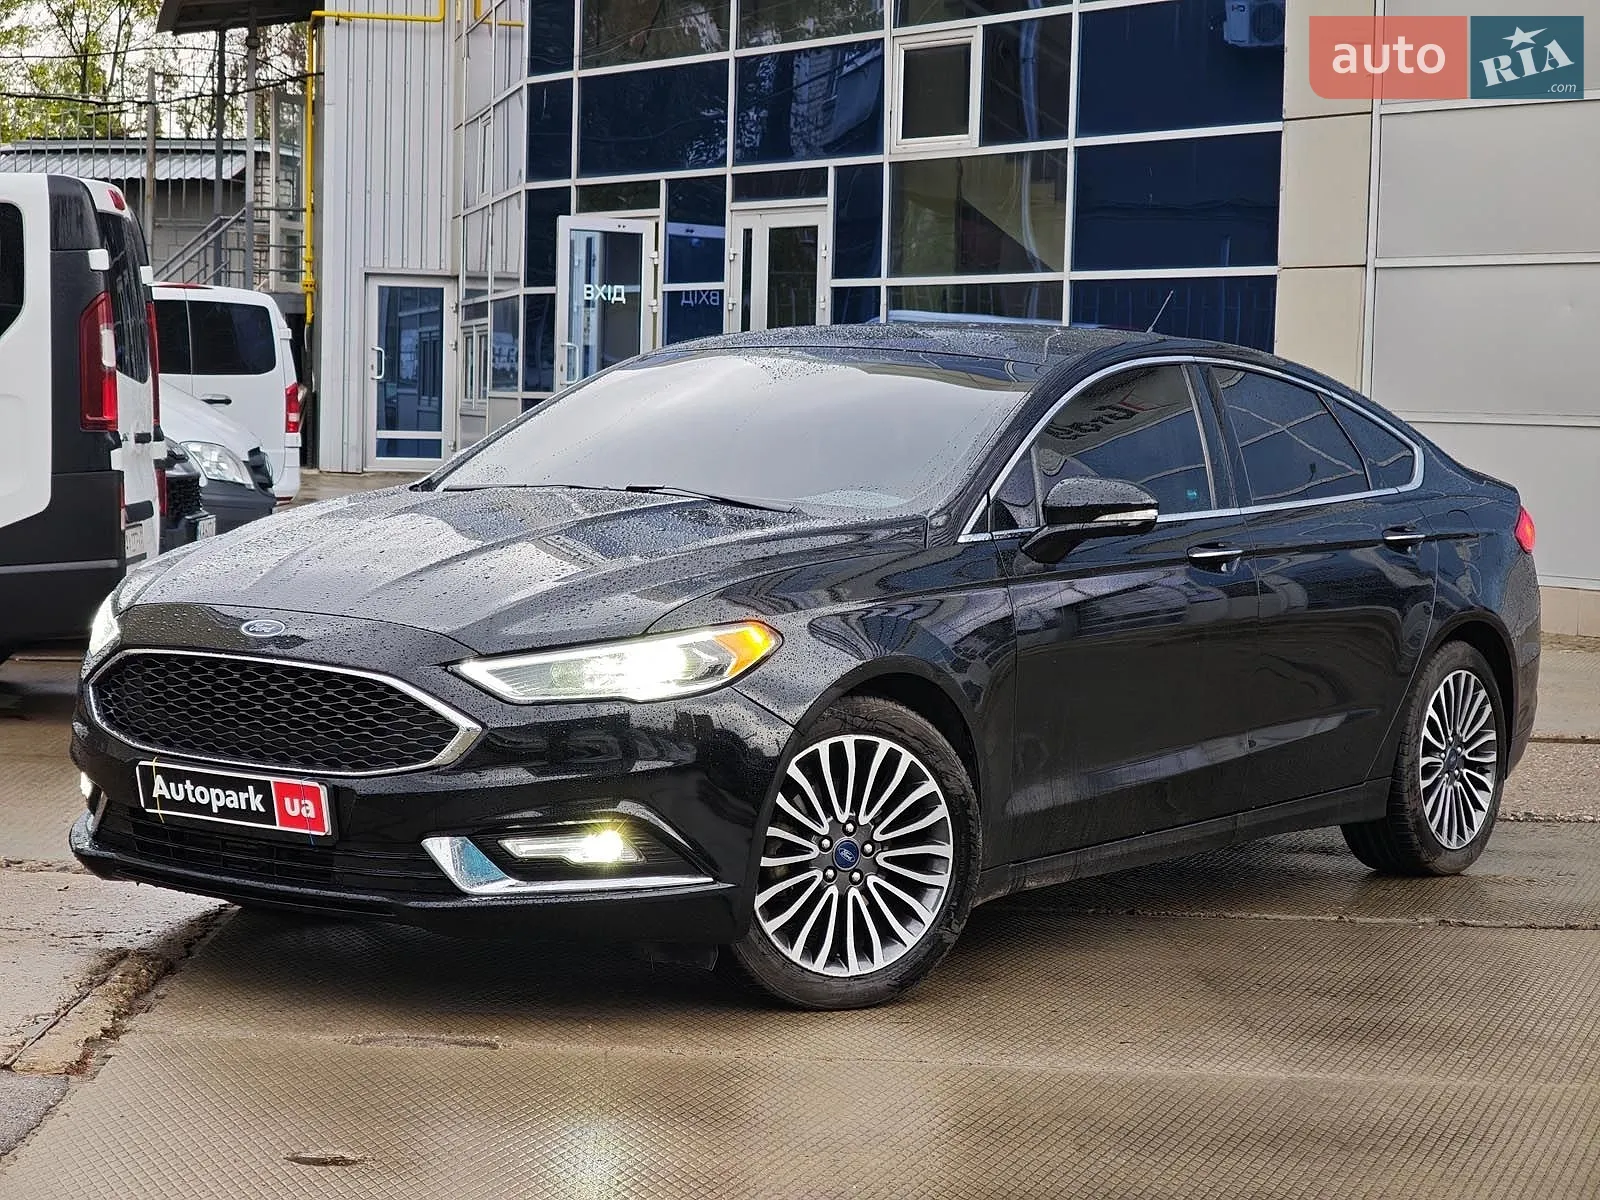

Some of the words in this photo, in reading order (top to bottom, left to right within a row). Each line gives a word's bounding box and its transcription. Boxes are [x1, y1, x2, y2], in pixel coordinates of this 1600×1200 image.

[583, 284, 626, 304] ВХІД
[152, 774, 266, 813] Autopark
[284, 797, 316, 819] ua
